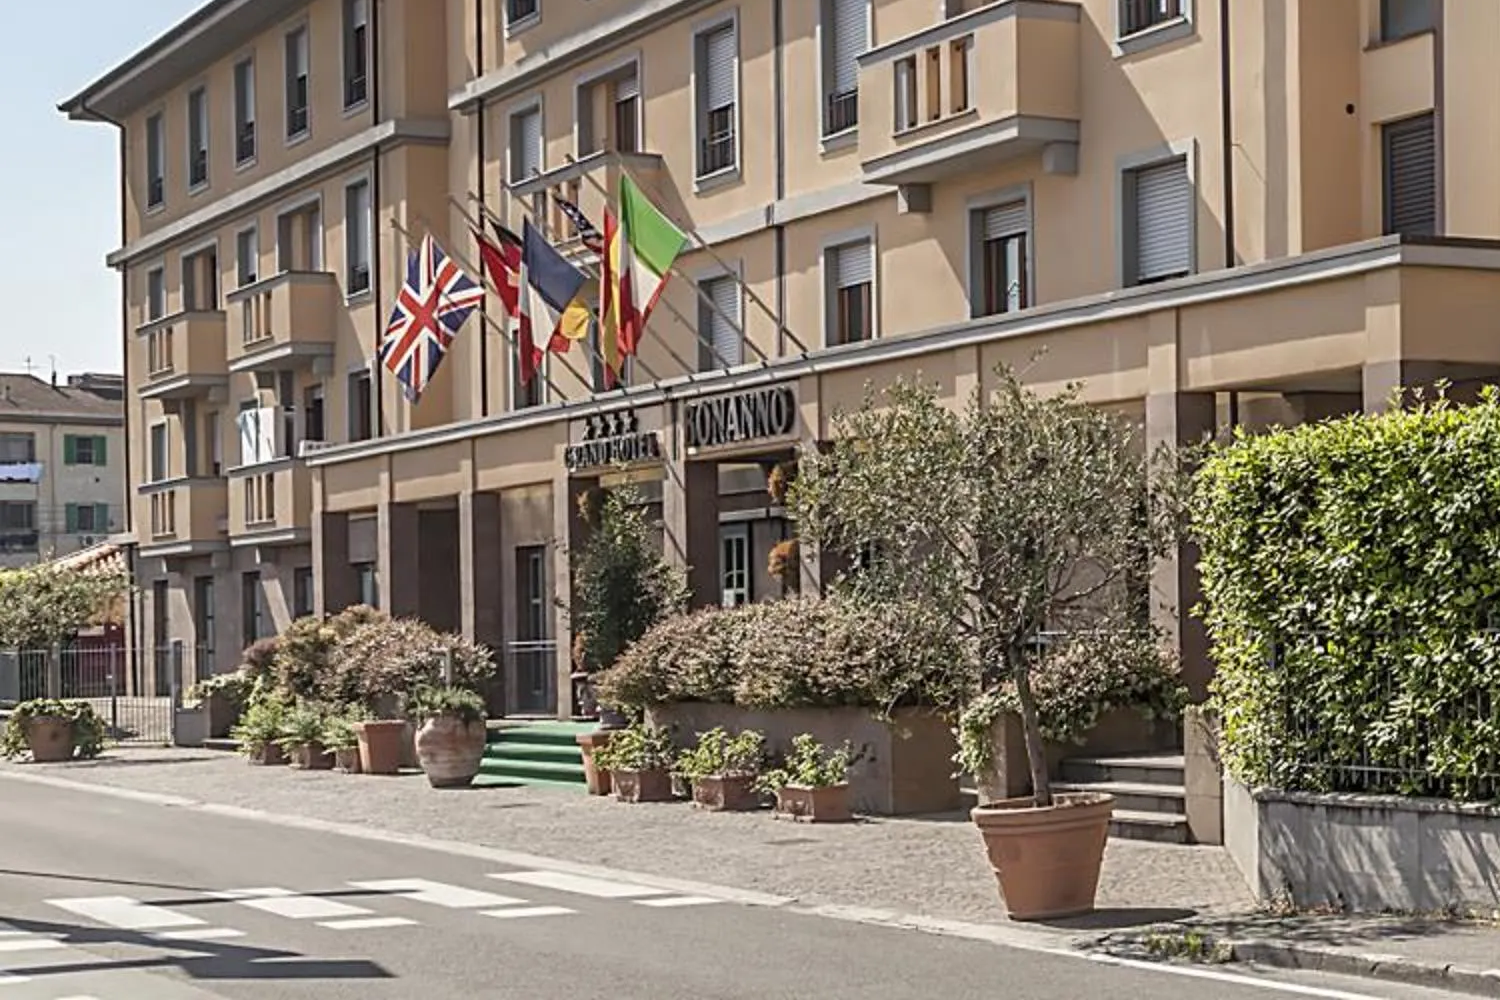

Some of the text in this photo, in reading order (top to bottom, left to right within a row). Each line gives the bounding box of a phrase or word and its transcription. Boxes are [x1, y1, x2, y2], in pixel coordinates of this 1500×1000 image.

[685, 388, 790, 446] BONANNO
[565, 432, 656, 469] GRAND HOTEL
